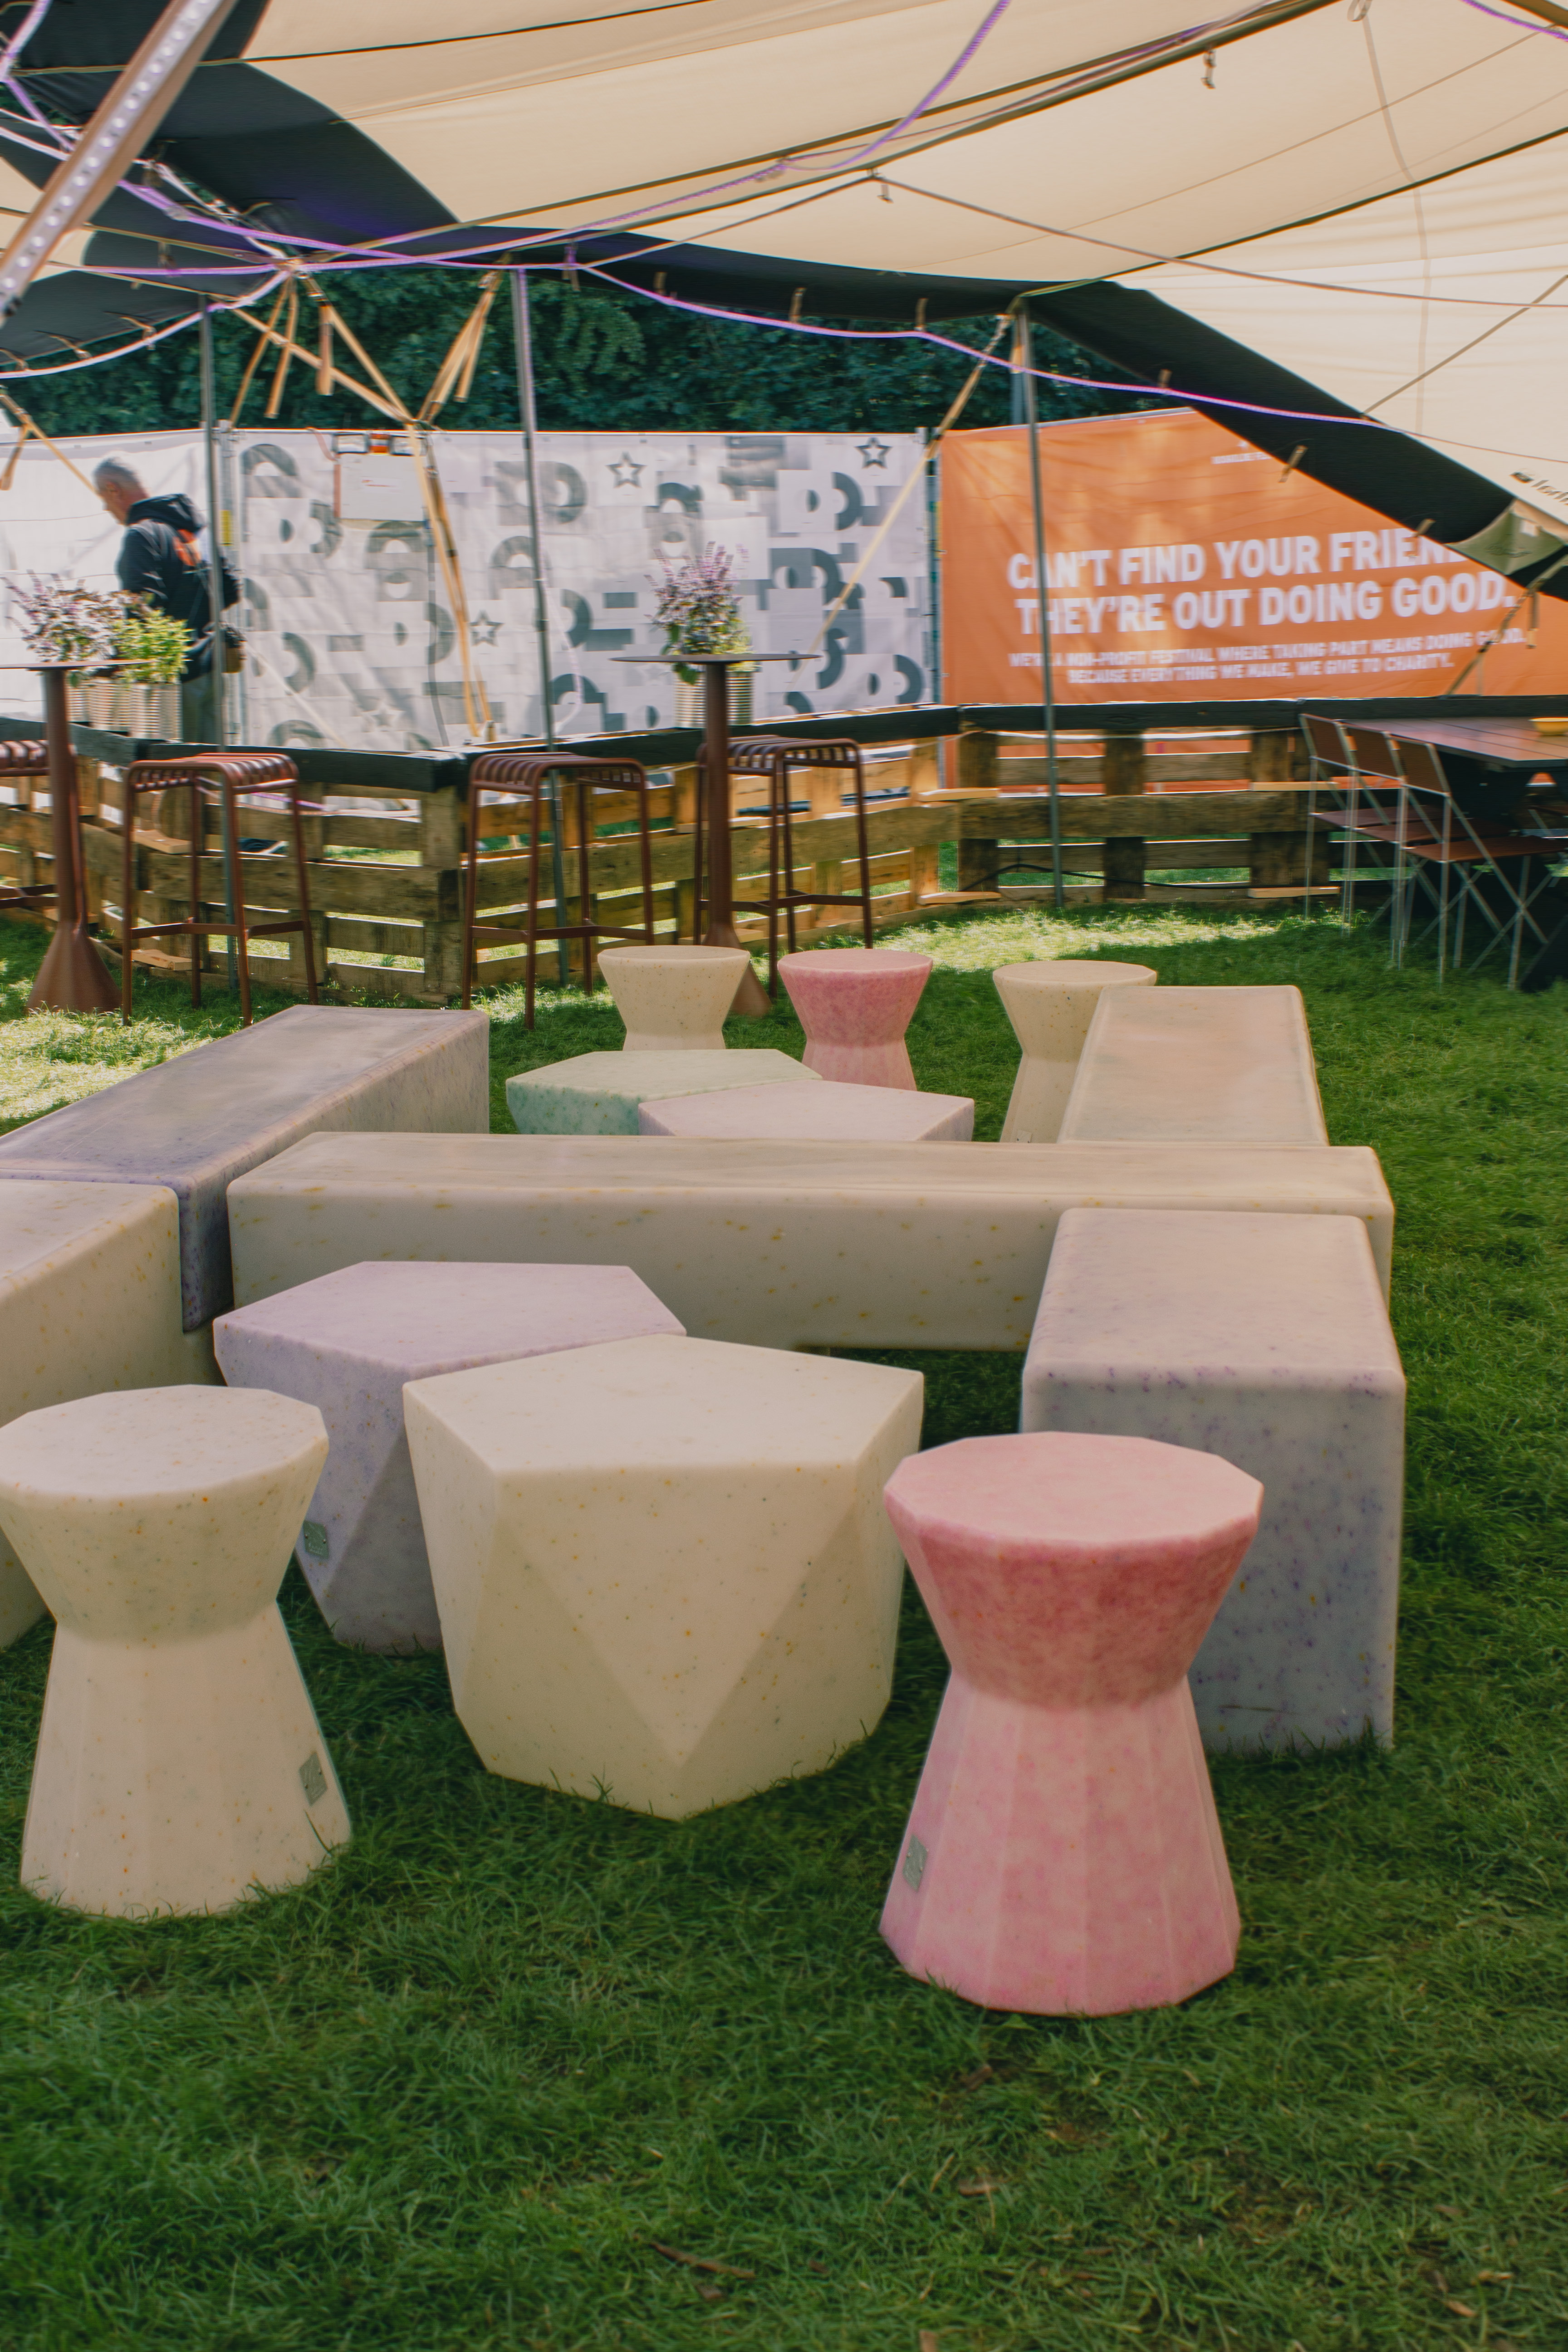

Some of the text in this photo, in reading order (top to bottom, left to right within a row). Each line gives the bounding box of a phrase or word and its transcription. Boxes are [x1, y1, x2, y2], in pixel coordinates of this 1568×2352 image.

[1008, 550, 1112, 589] CAN'T
[1119, 544, 1205, 585] FIND
[1213, 536, 1321, 578] YOUR
[1330, 528, 1466, 571] FRIEN
[1014, 571, 1516, 634] THEY'RE OUT DOING GOOD.
[1217, 646, 1272, 661] WHERE
[1328, 640, 1369, 656] PART
[1370, 638, 1423, 654] MEANS
[1425, 632, 1472, 650] DOING
[1219, 665, 1248, 678] WE
[1297, 661, 1322, 675] WE
[1323, 659, 1361, 674] GIVE
[1361, 658, 1382, 672] TO
